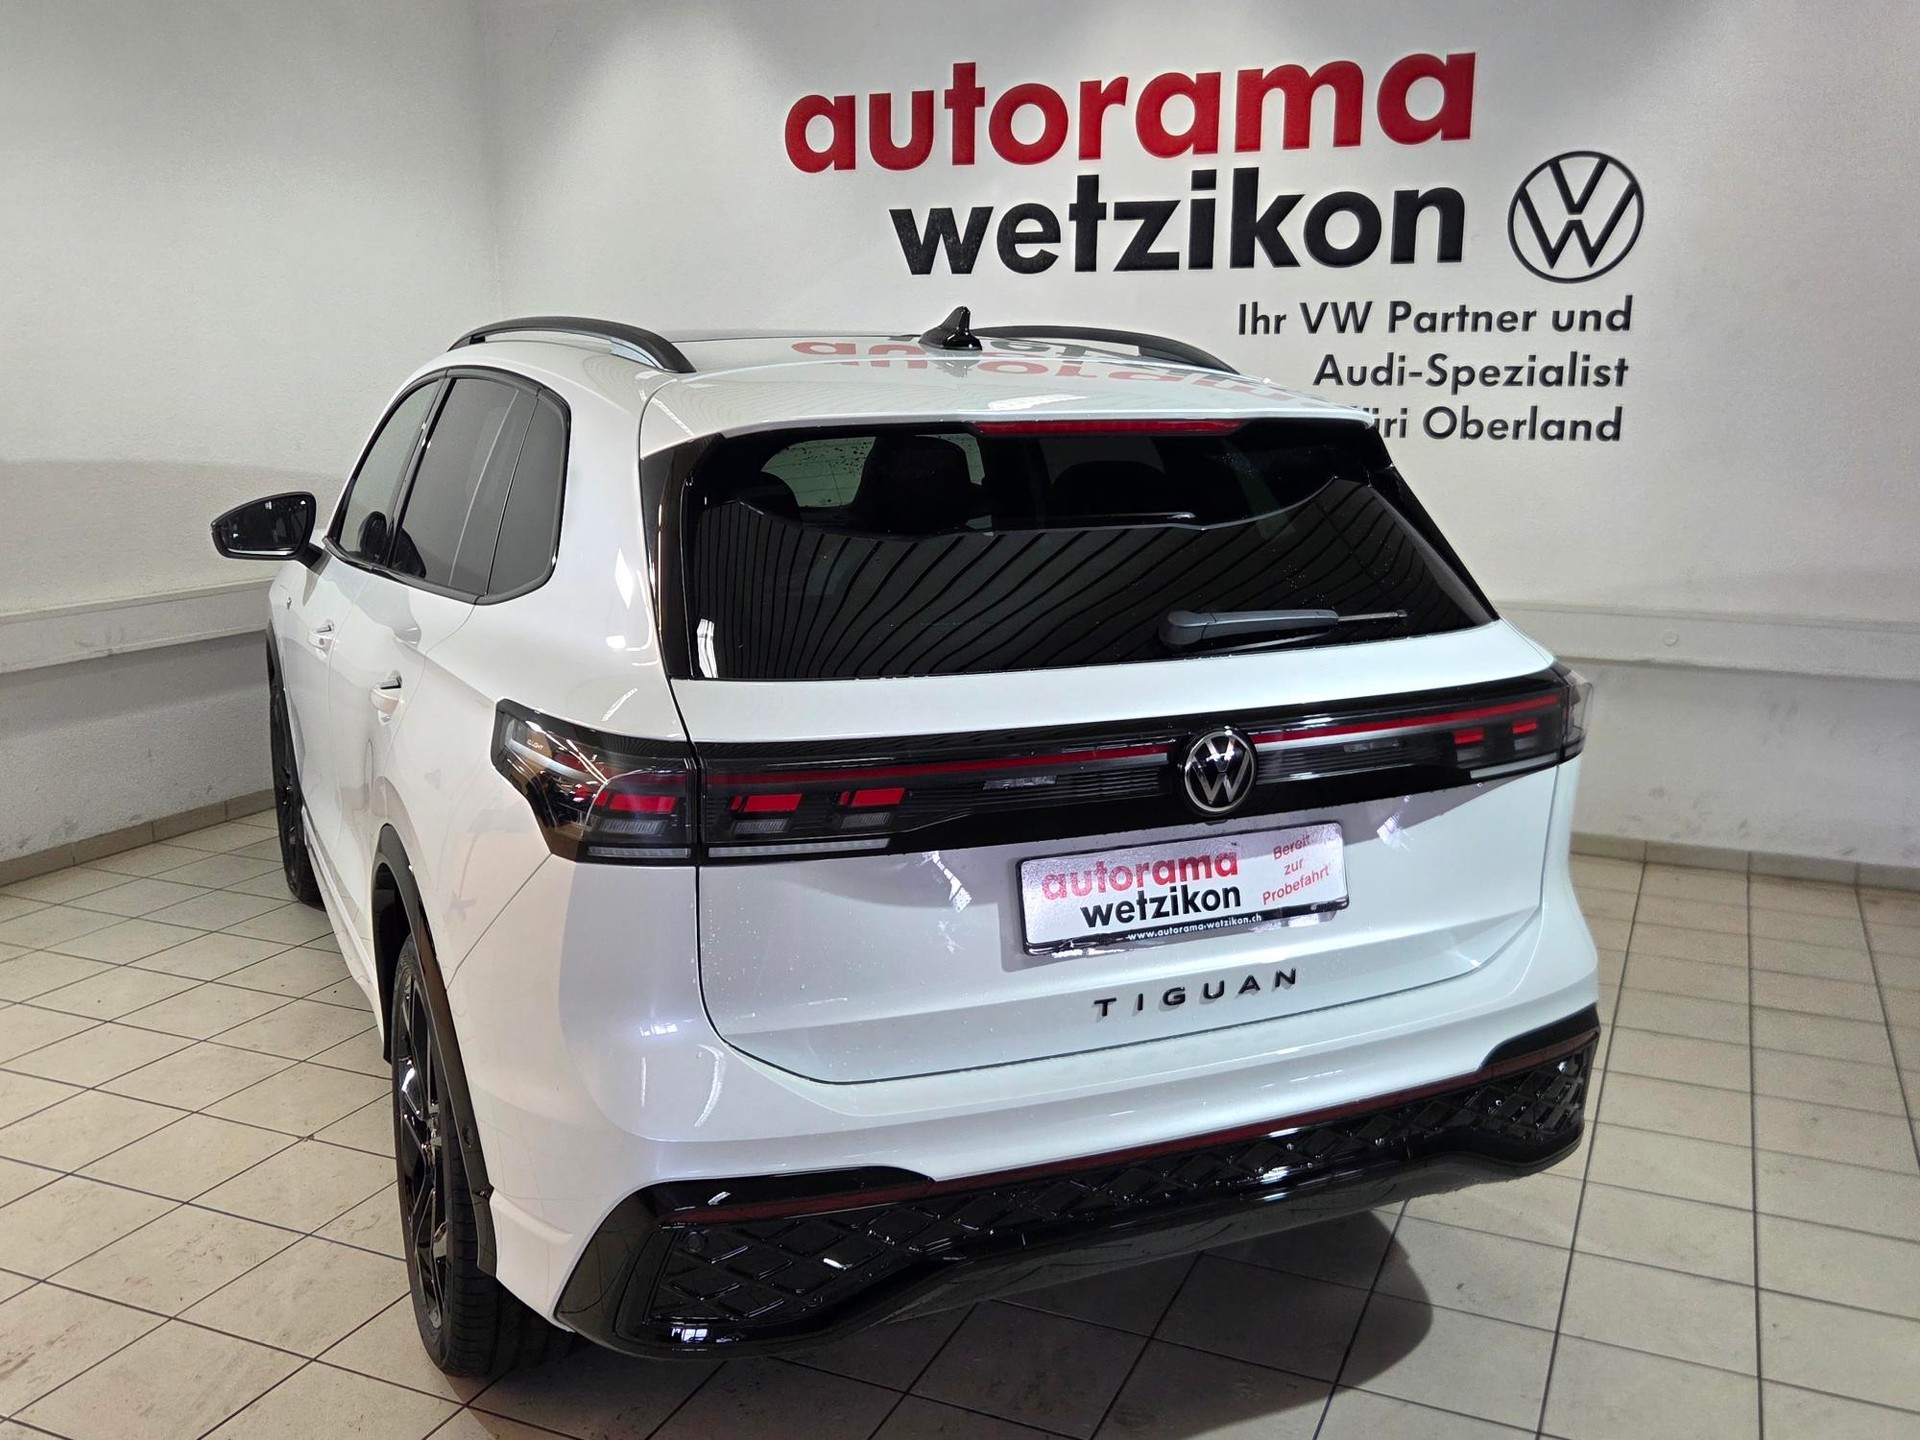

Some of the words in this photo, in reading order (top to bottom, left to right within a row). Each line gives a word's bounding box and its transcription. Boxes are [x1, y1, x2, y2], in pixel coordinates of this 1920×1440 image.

[784, 52, 1476, 173] autorama
[889, 167, 1466, 276] wetzikon
[1238, 302, 1287, 335] Ihr
[1300, 301, 1373, 334] VW
[1388, 301, 1538, 334] Partner
[1551, 295, 1633, 333] und
[1312, 351, 1629, 395] Audi-Spezialist
[1422, 405, 1623, 442] Oberland
[1273, 834, 1311, 860] Bereit
[1283, 858, 1305, 876] zur
[1041, 852, 1239, 900] autorama
[1262, 865, 1330, 905] Probefahrt
[1080, 885, 1241, 928] wetzikon
[1127, 912, 1263, 941] www.autorama-wetzikon.ch
[1093, 967, 1297, 1018] TIGUAN
